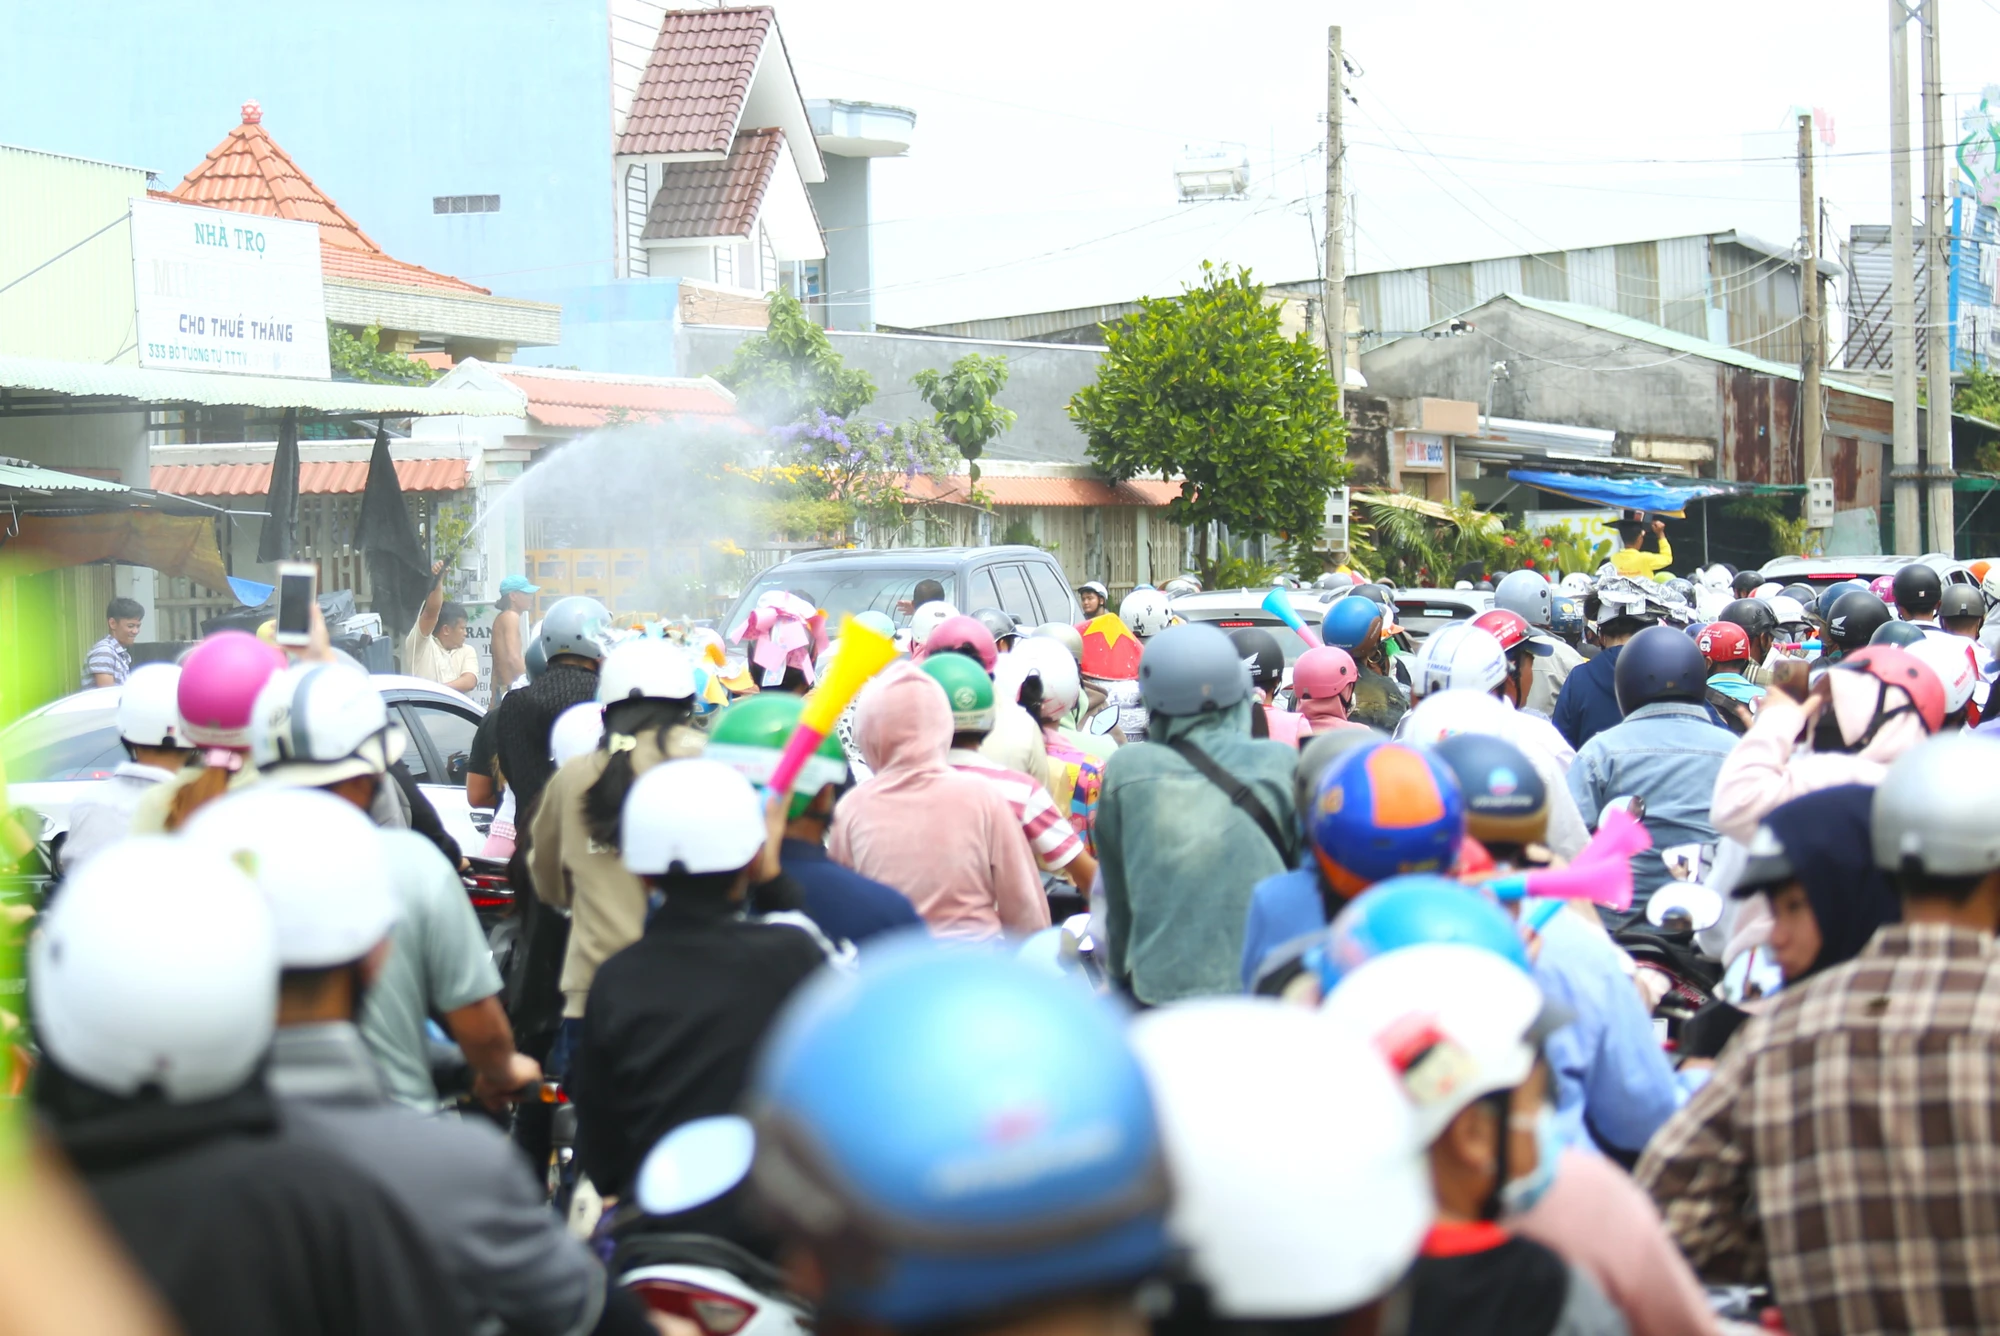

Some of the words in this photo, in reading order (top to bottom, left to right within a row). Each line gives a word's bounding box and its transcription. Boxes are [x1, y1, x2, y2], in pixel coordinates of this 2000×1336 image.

[195, 219, 228, 247] NHÀ
[234, 228, 265, 259] TRỌ
[179, 314, 205, 335] CHO
[251, 316, 293, 342] THÁNG
[148, 343, 166, 359] 333
